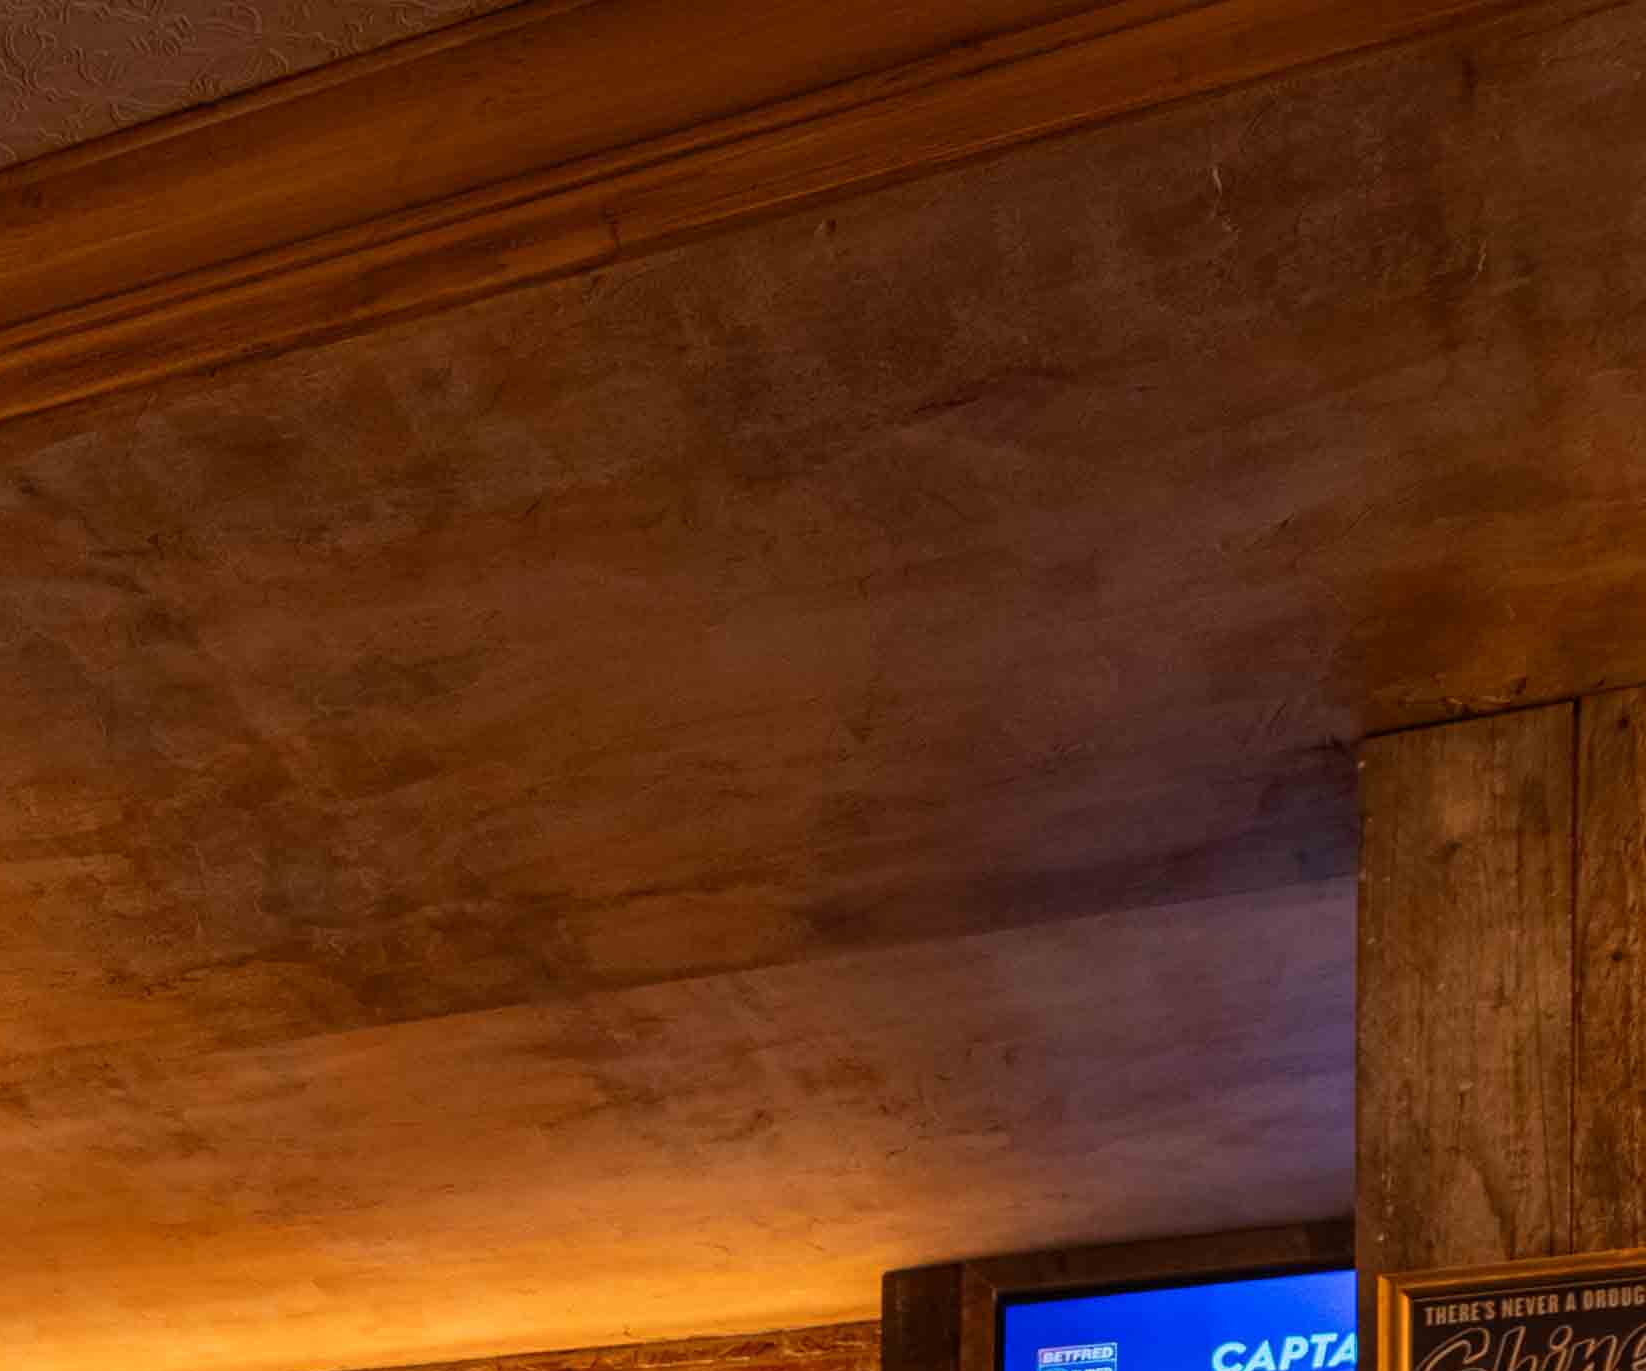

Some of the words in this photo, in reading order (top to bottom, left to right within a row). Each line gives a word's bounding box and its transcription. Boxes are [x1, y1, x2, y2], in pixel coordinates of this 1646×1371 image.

[1425, 1299, 1496, 1327] THERE'S
[1501, 1294, 1559, 1319] NEVER
[1566, 1292, 1578, 1312] A
[1042, 1347, 1113, 1364] BETFRED
